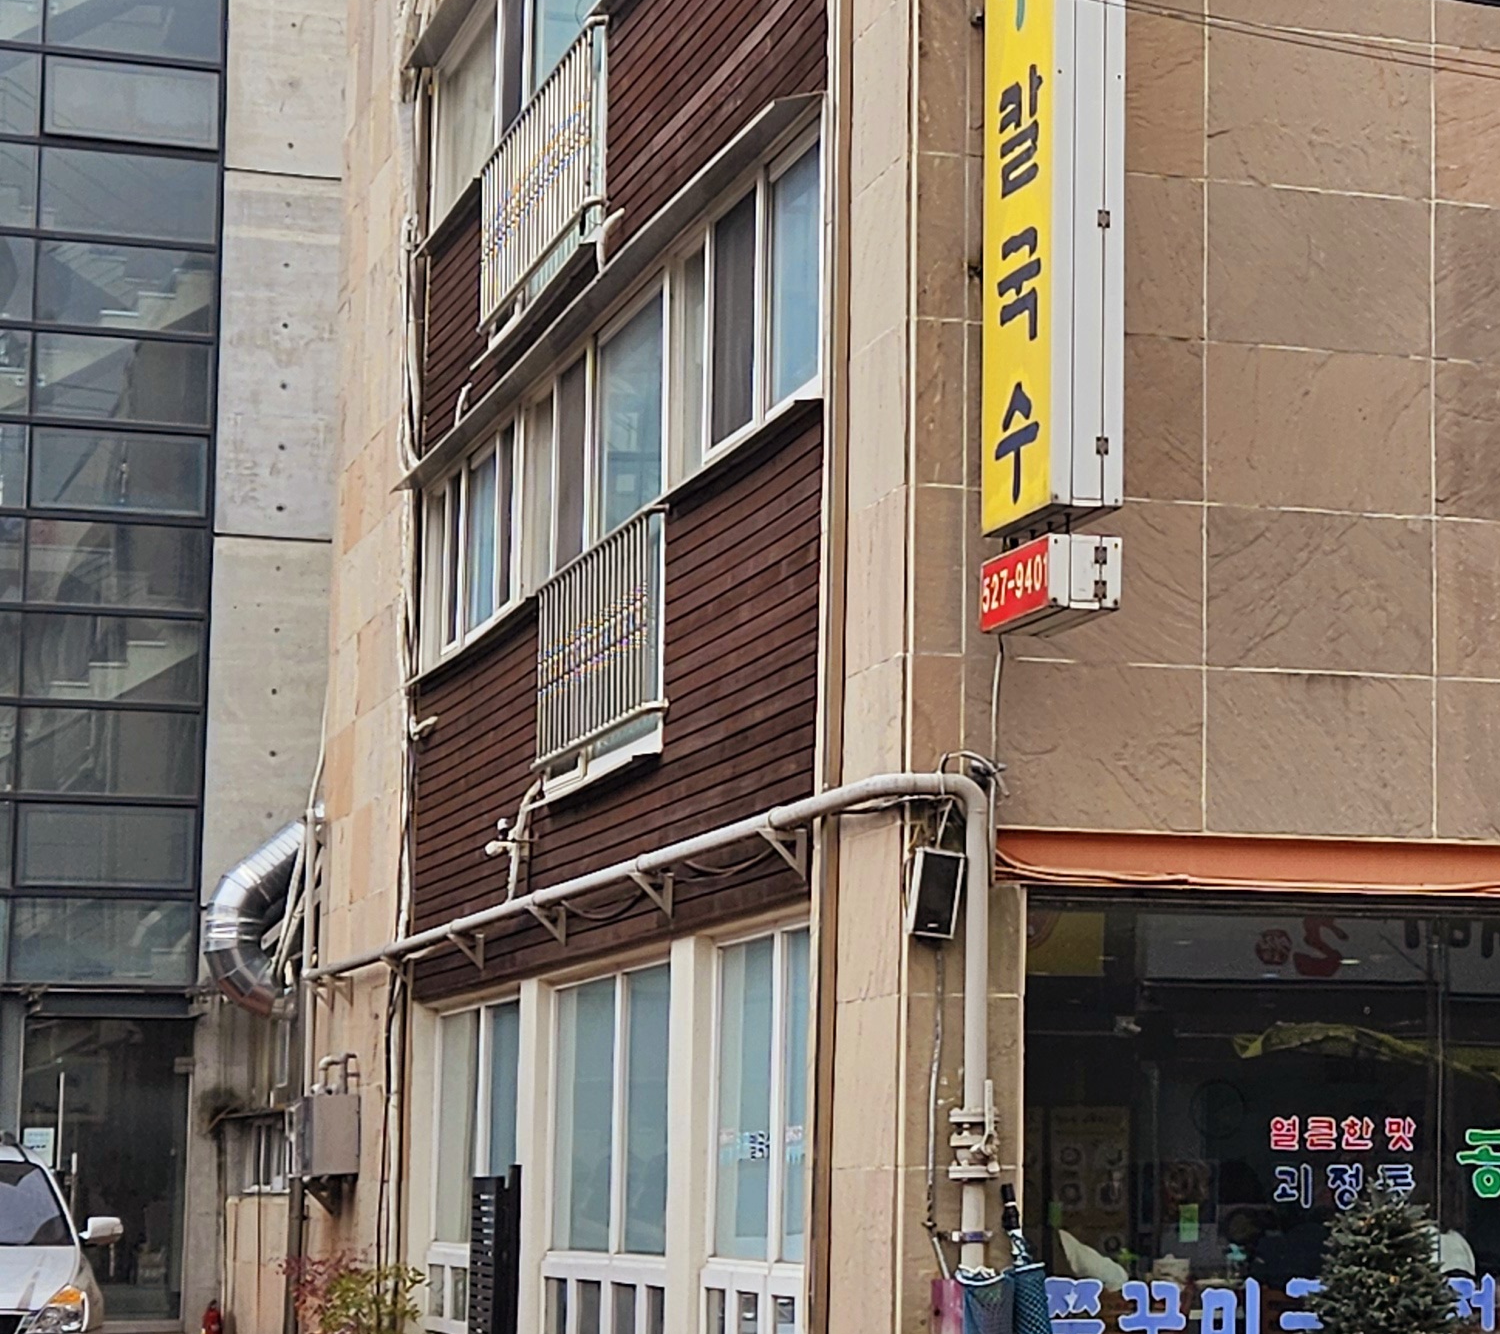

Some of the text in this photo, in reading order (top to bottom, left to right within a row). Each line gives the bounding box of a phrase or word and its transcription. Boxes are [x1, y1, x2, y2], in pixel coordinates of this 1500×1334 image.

[994, 64, 1043, 505] 칼국수
[982, 552, 1048, 614] 527-9401
[1270, 1115, 1417, 1152] 얼큰한 맛
